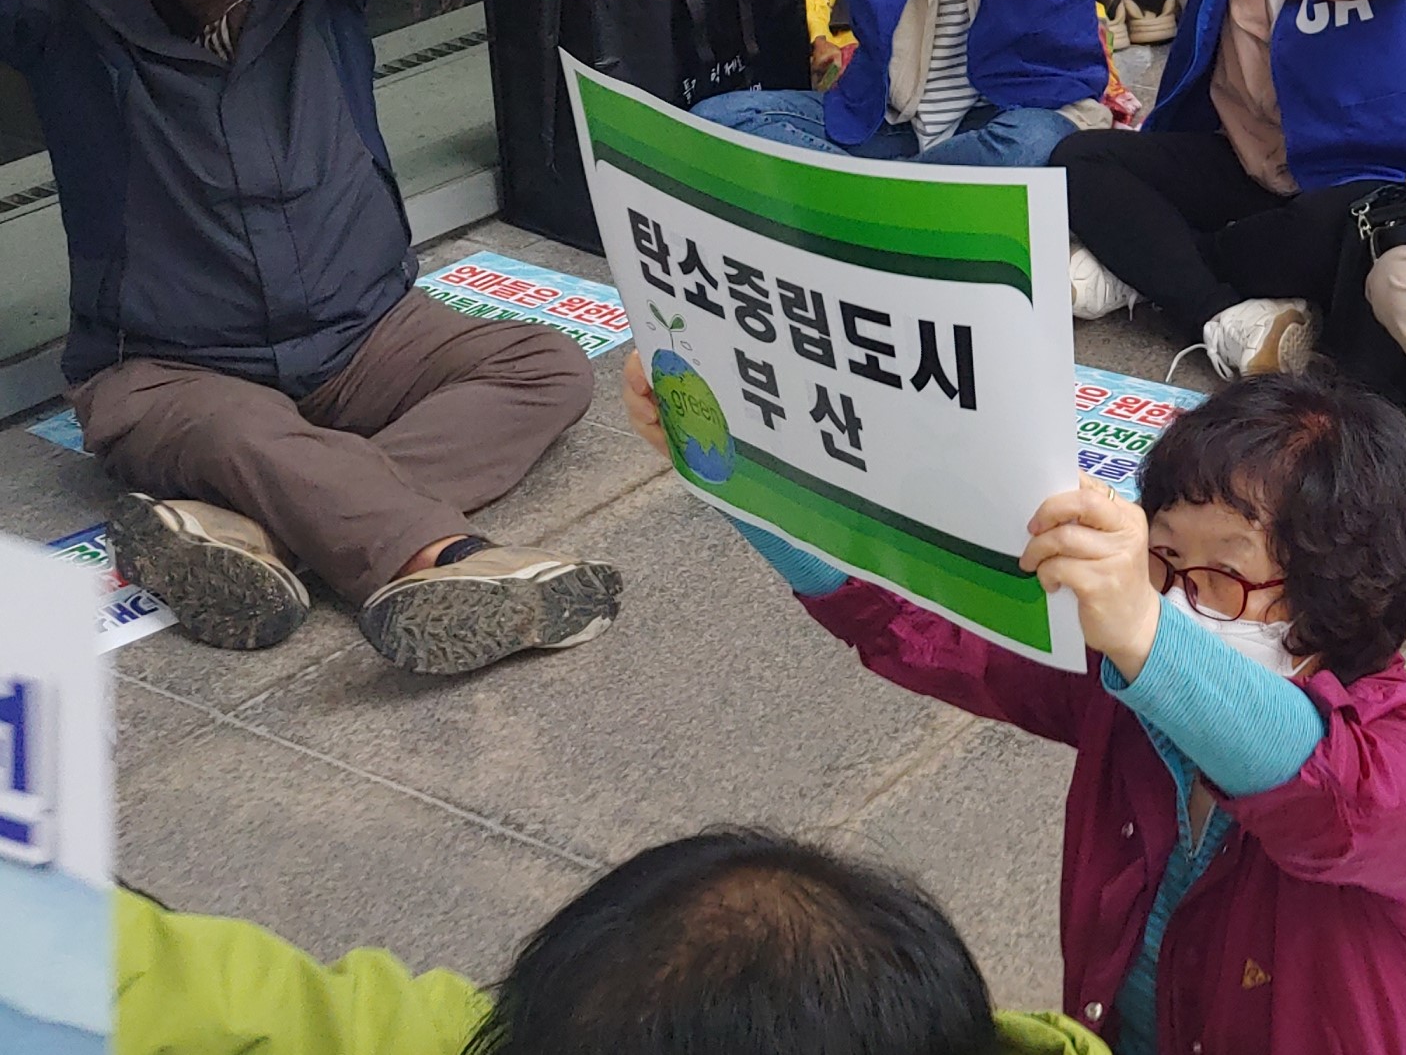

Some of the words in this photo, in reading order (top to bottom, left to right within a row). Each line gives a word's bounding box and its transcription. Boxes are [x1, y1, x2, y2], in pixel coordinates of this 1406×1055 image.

[439, 265, 561, 308] 엄마들은
[627, 207, 977, 411] 탄소중립도시
[670, 389, 722, 433] green
